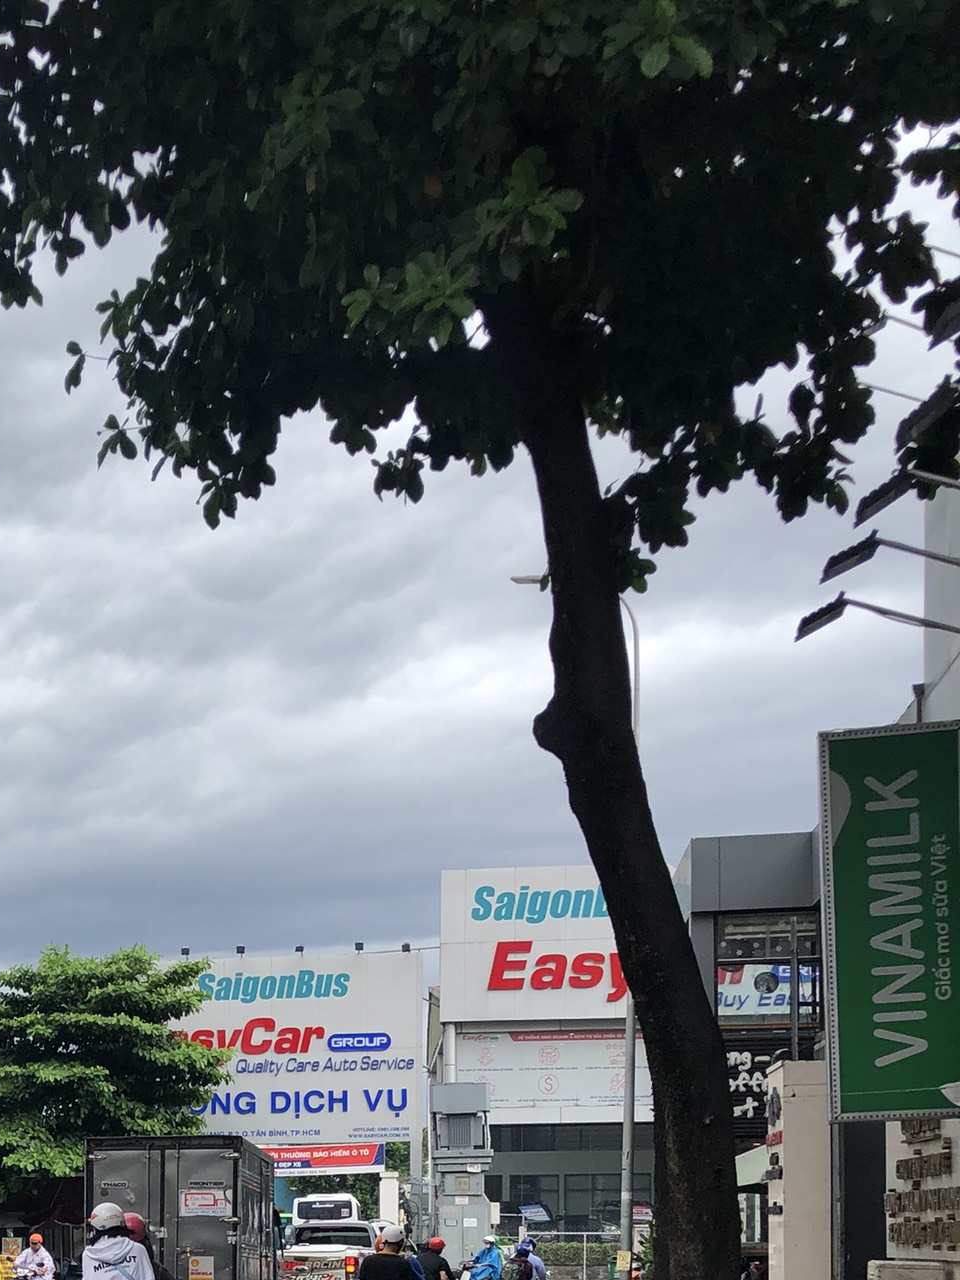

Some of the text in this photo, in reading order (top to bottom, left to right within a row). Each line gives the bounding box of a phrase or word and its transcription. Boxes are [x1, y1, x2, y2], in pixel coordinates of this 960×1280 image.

[930, 834, 950, 876] Việt
[932, 880, 949, 917] sữa
[864, 769, 928, 1067] VINAMILK
[935, 922, 949, 953] mơ
[198, 970, 350, 1003] SaigonBus
[171, 1017, 387, 1055] syCar GROUP
[236, 1055, 415, 1077] Quality Care Auto Service
[270, 1089, 348, 1119] DỊCH
[363, 1088, 408, 1118] VỤ
